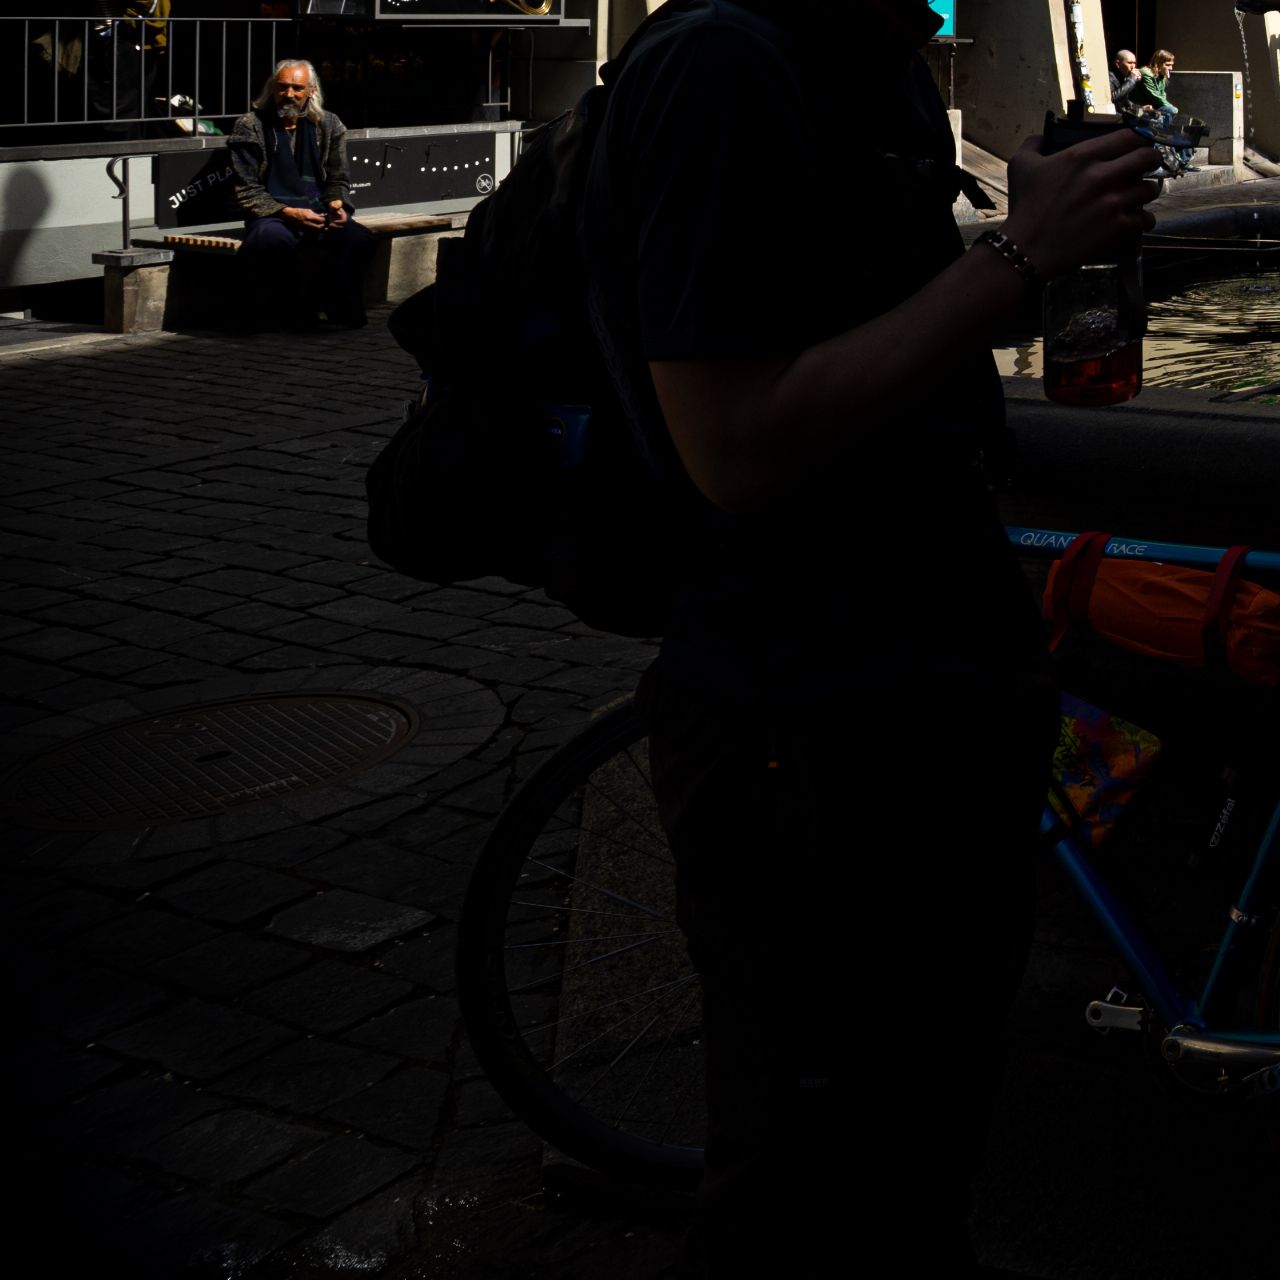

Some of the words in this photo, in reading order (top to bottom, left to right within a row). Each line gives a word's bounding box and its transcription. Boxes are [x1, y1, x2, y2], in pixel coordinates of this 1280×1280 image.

[167, 179, 205, 209] JUST
[207, 166, 235, 189] PLA
[1020, 532, 1076, 549] QUAN
